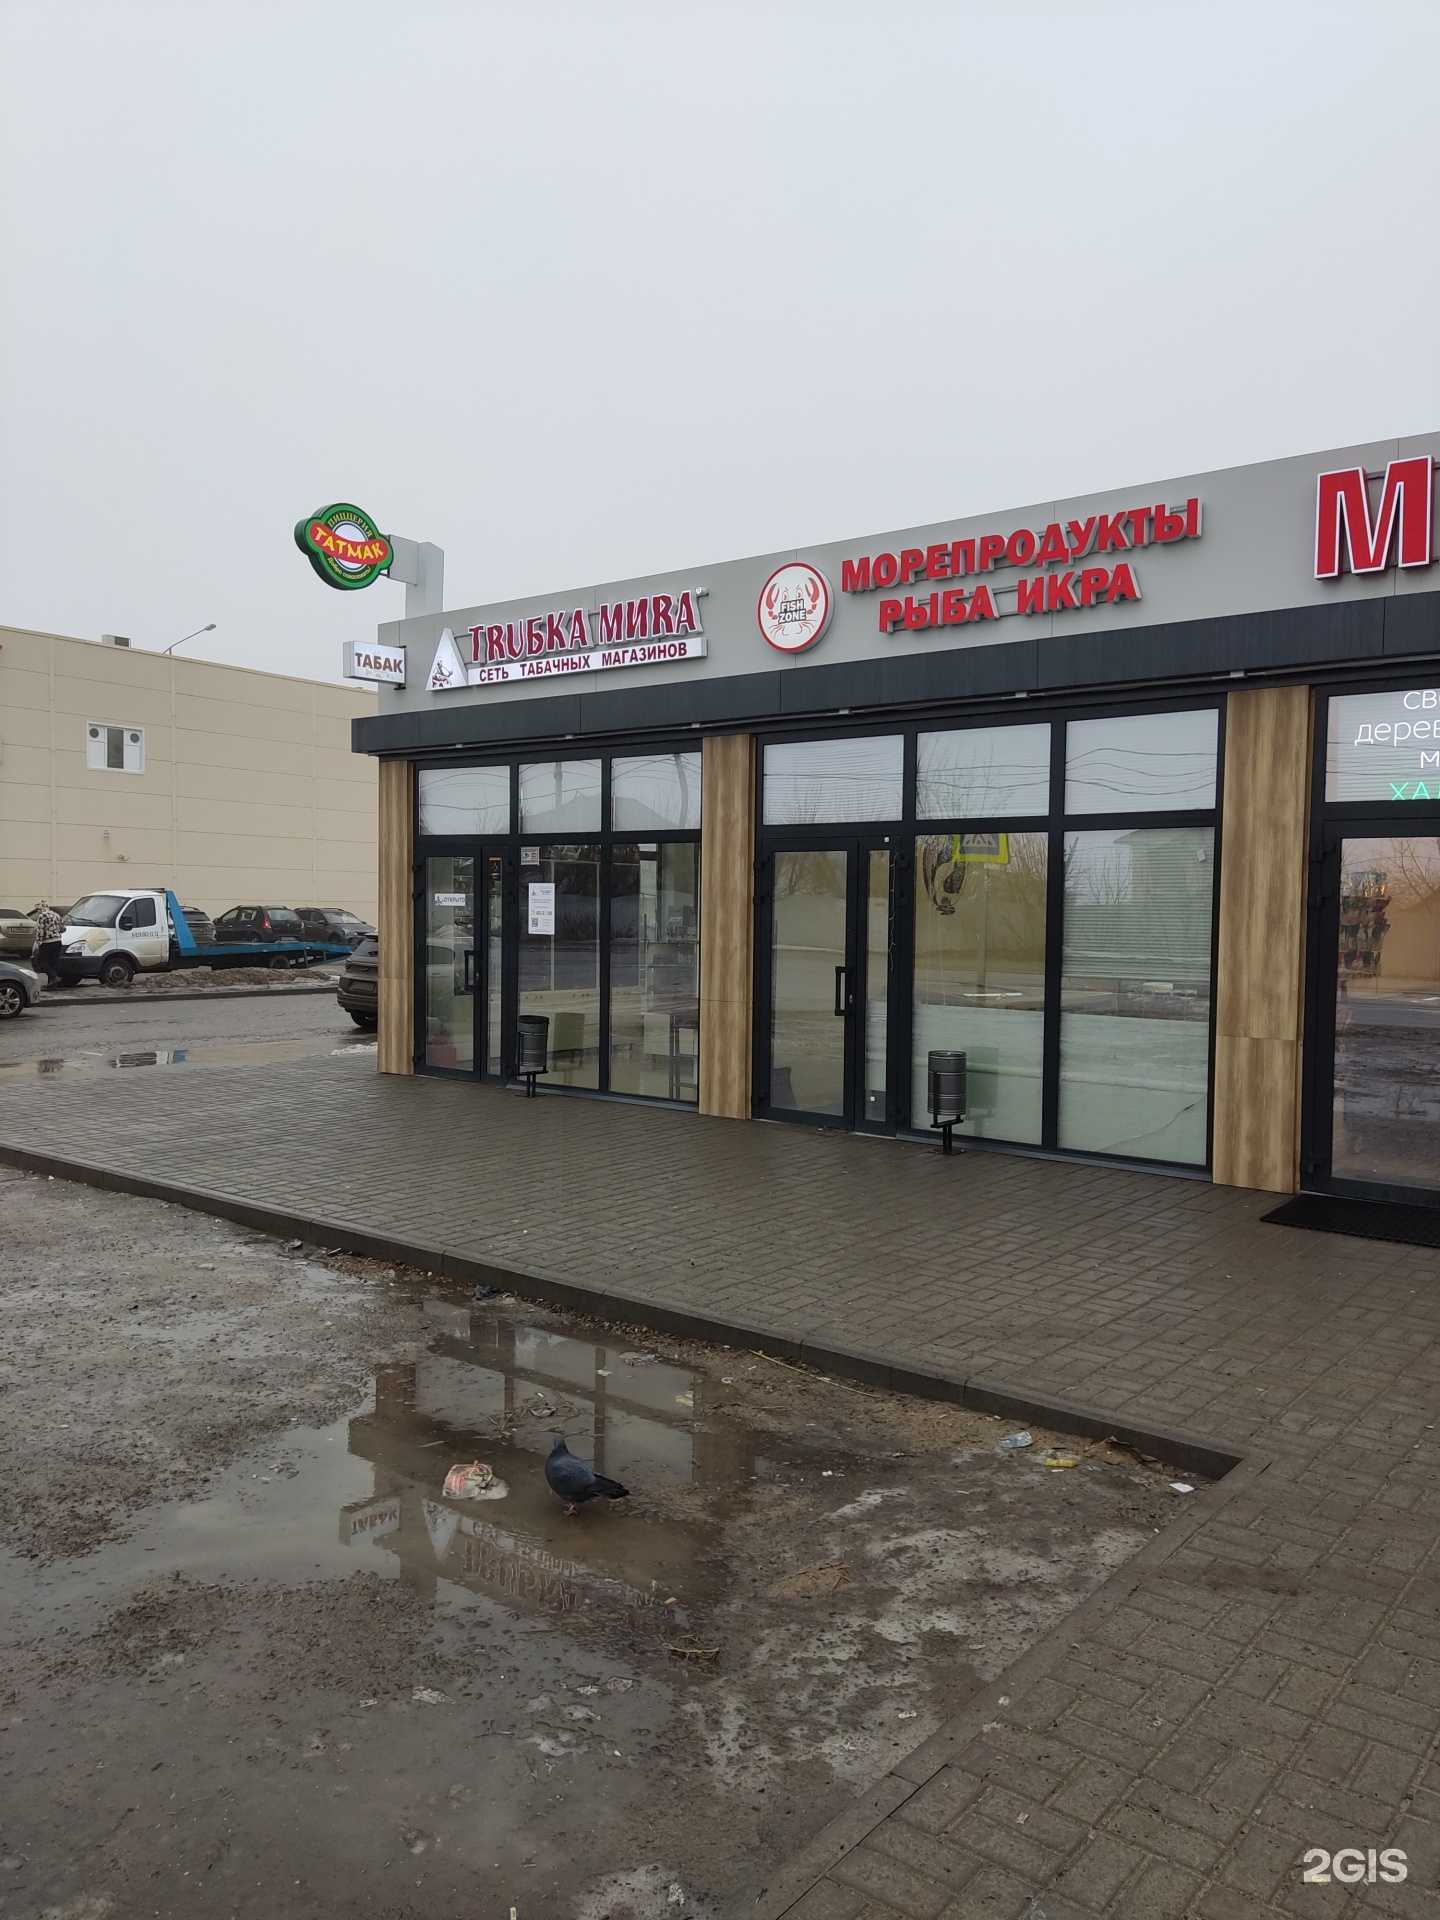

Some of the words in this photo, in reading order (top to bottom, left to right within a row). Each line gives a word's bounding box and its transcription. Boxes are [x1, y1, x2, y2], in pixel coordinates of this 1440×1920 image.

[1314, 455, 1440, 580] М
[314, 526, 384, 561] ТАТМАК
[841, 498, 1202, 593] МОРЕПРОДУКТЫ
[781, 599, 804, 612] FISH
[879, 584, 1000, 633] РЫБА
[1016, 562, 1143, 616] ИКРА
[778, 609, 807, 624] ZONE
[355, 652, 403, 674] ТАБАК
[479, 668, 509, 682] СЕТЬ
[520, 655, 591, 677] ТАБАЧНЫХ
[601, 642, 688, 667] МАГАЗИНОВ
[1390, 781, 1440, 801] ХА
